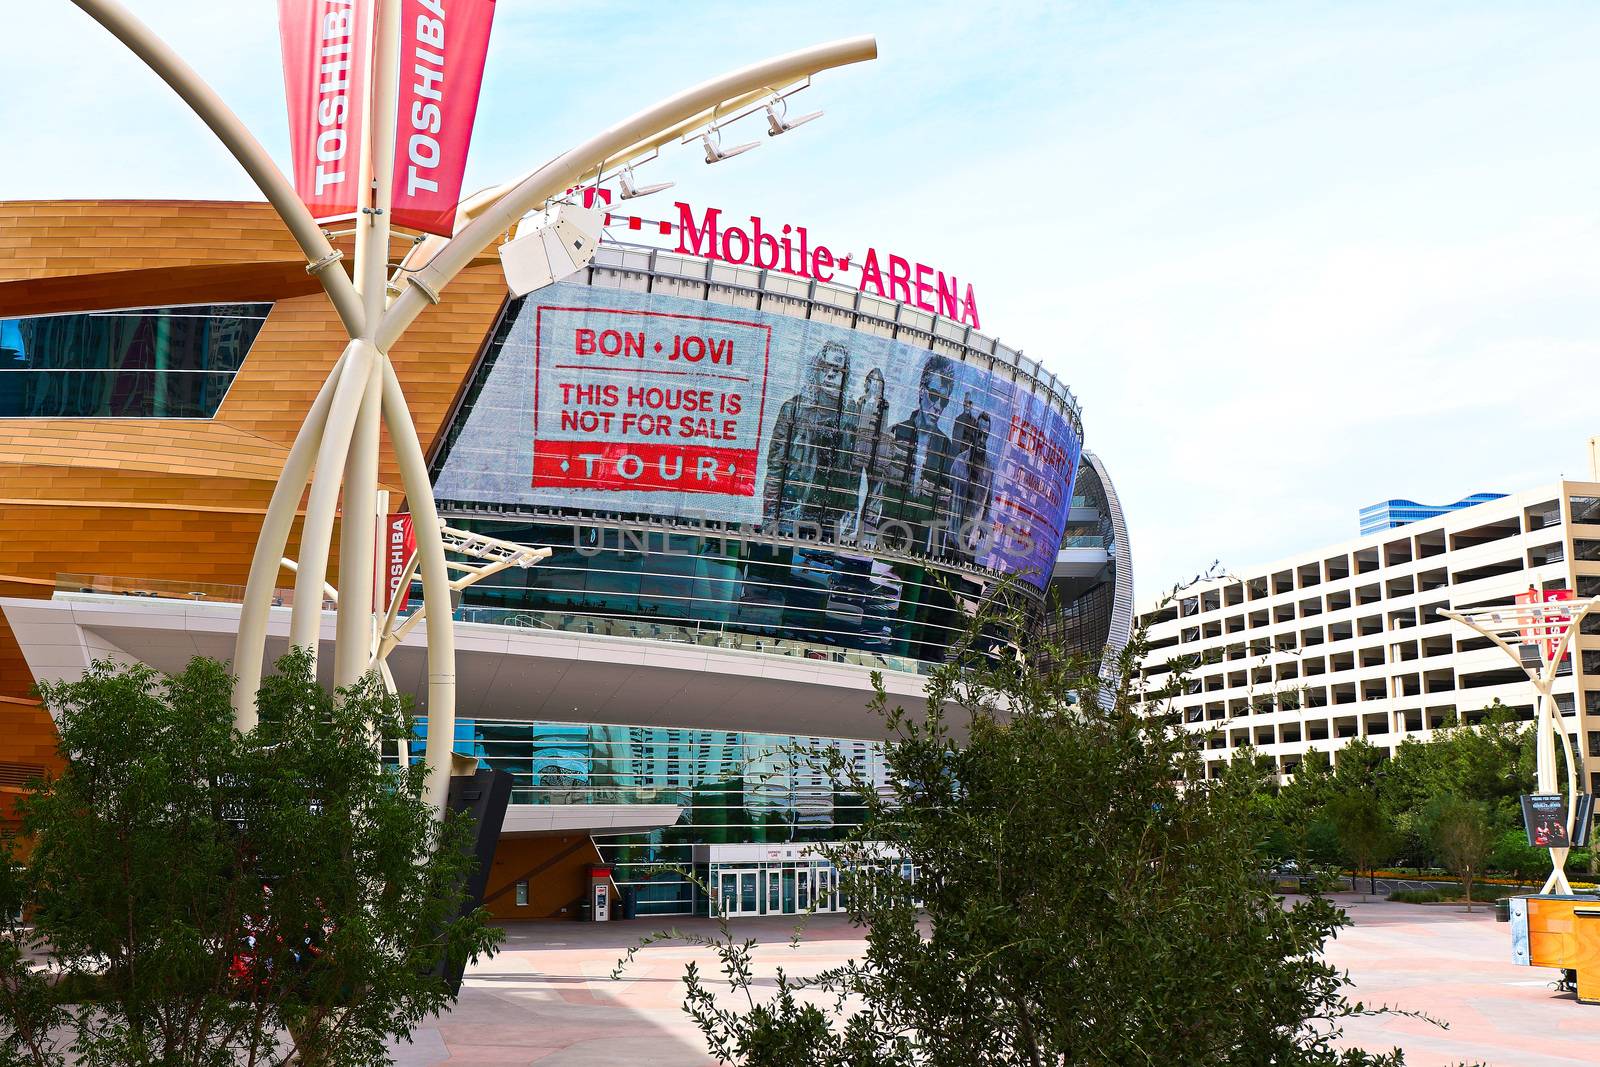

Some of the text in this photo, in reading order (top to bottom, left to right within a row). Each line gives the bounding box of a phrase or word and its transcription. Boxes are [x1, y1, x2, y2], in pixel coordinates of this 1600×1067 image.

[314, 0, 351, 196] TOSHIB
[673, 201, 835, 283] Mobile
[858, 247, 981, 331] ARENA
[575, 328, 734, 366] BON JOVI
[559, 383, 742, 416] THIS HOUSE IS
[561, 410, 737, 441] NOT FOR SALE
[578, 453, 718, 482] TOUR
[1548, 594, 1560, 653] TOSHA
